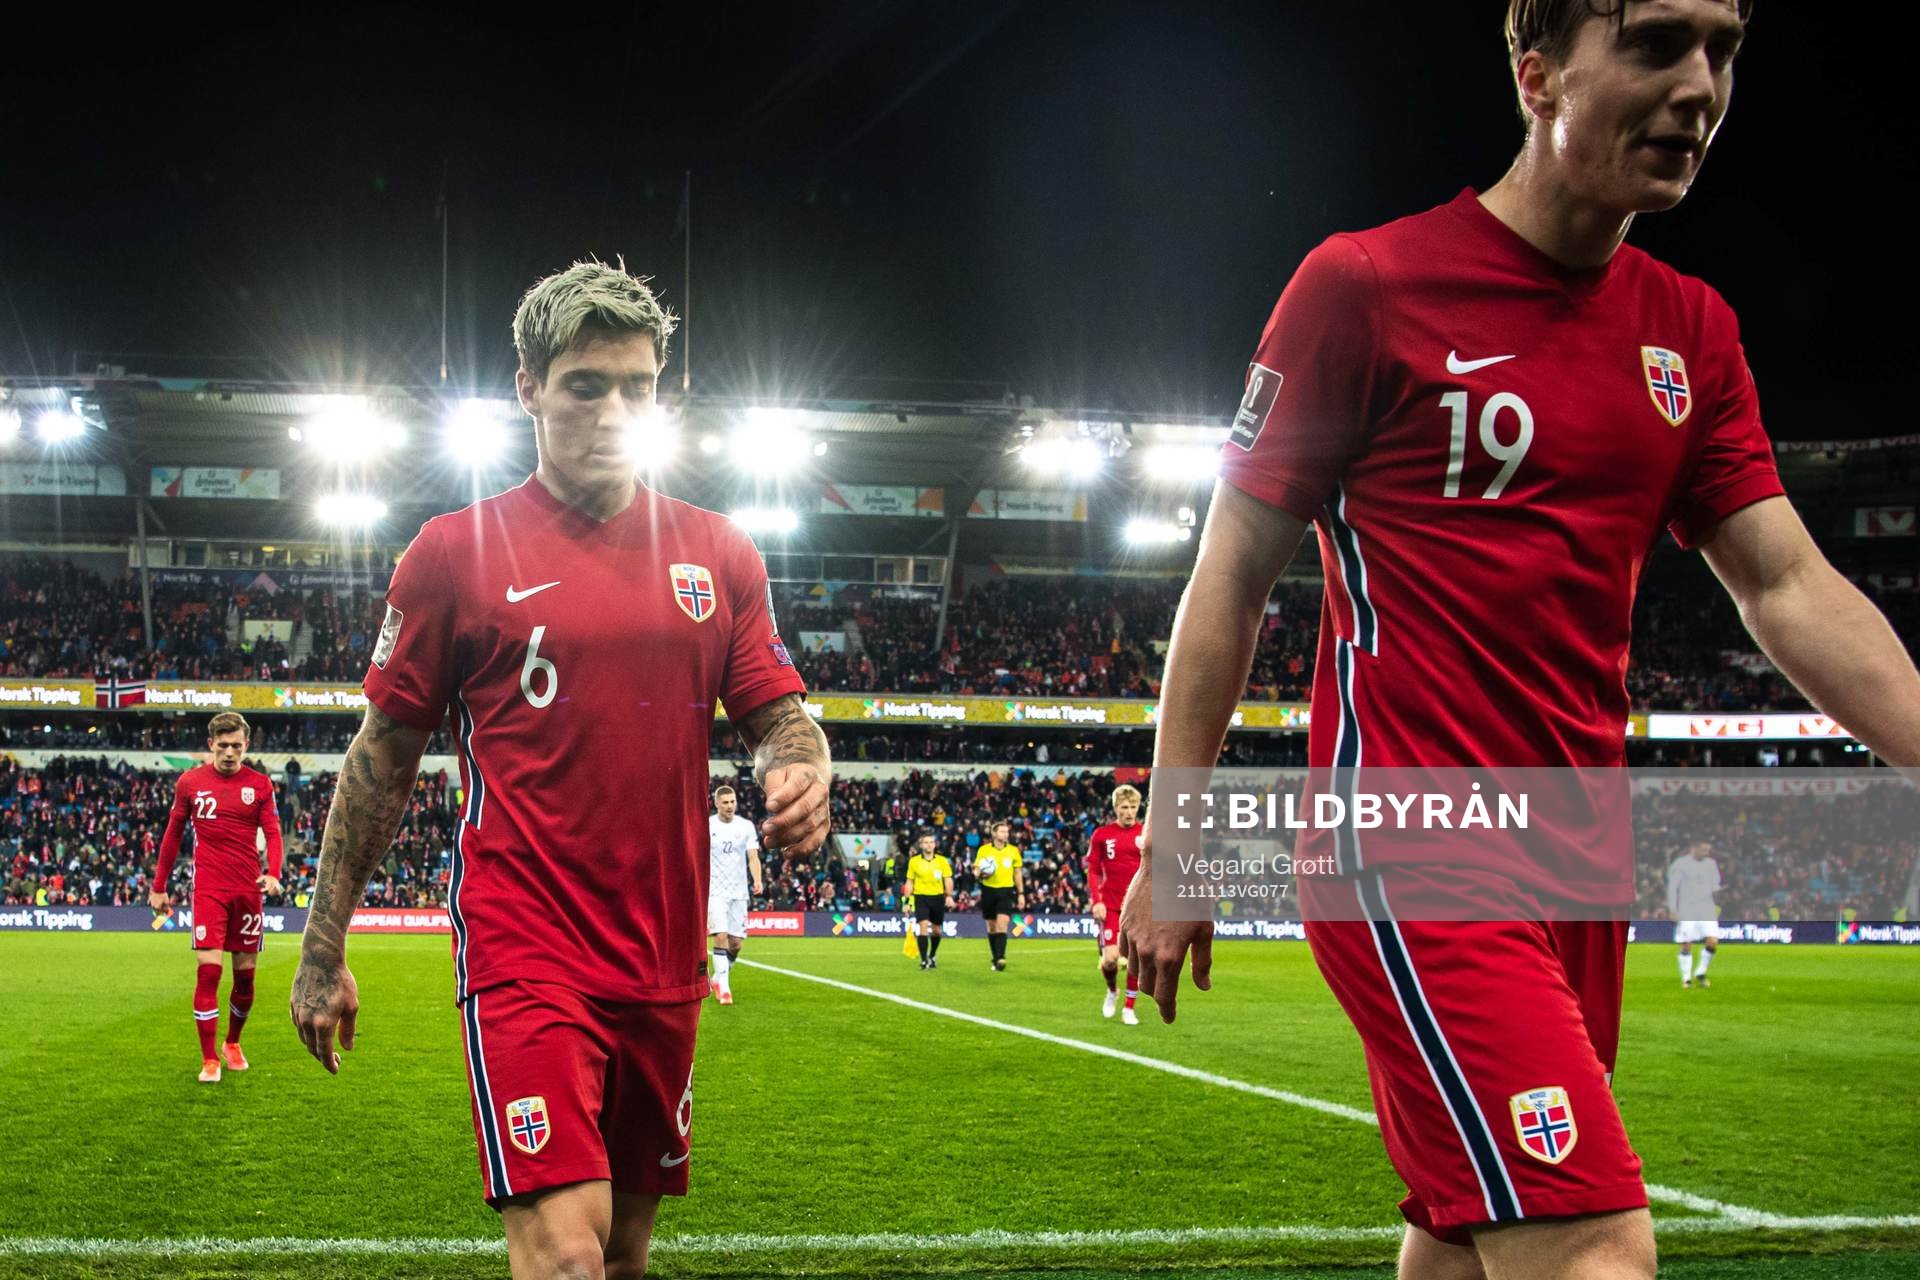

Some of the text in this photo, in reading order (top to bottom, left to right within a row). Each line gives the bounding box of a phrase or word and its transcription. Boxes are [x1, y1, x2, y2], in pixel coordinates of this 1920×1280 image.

[1438, 391, 1534, 500] 19
[520, 625, 558, 709] 6
[32, 687, 81, 705] Tipping
[145, 688, 232, 707] Norsk Tipping
[295, 691, 333, 705] Norsk
[884, 702, 966, 720] Norsk Tipping
[1025, 705, 1106, 723] Norsk Tipping
[1690, 719, 1764, 736] VG
[1799, 718, 1846, 736] V
[194, 797, 217, 819] 22
[722, 841, 733, 854] 22
[1106, 843, 1116, 859] 5
[0, 910, 93, 931] orsk Tipping
[240, 914, 262, 936] 22
[351, 914, 402, 927] UROPEAN
[746, 917, 799, 930] UALIFIERS
[857, 916, 902, 933] Norsk
[1036, 918, 1080, 934] Norsk
[1213, 920, 1306, 939] Norsk Tipping
[1718, 924, 1792, 944] orsk Tipping
[1860, 925, 1892, 941] Norsk
